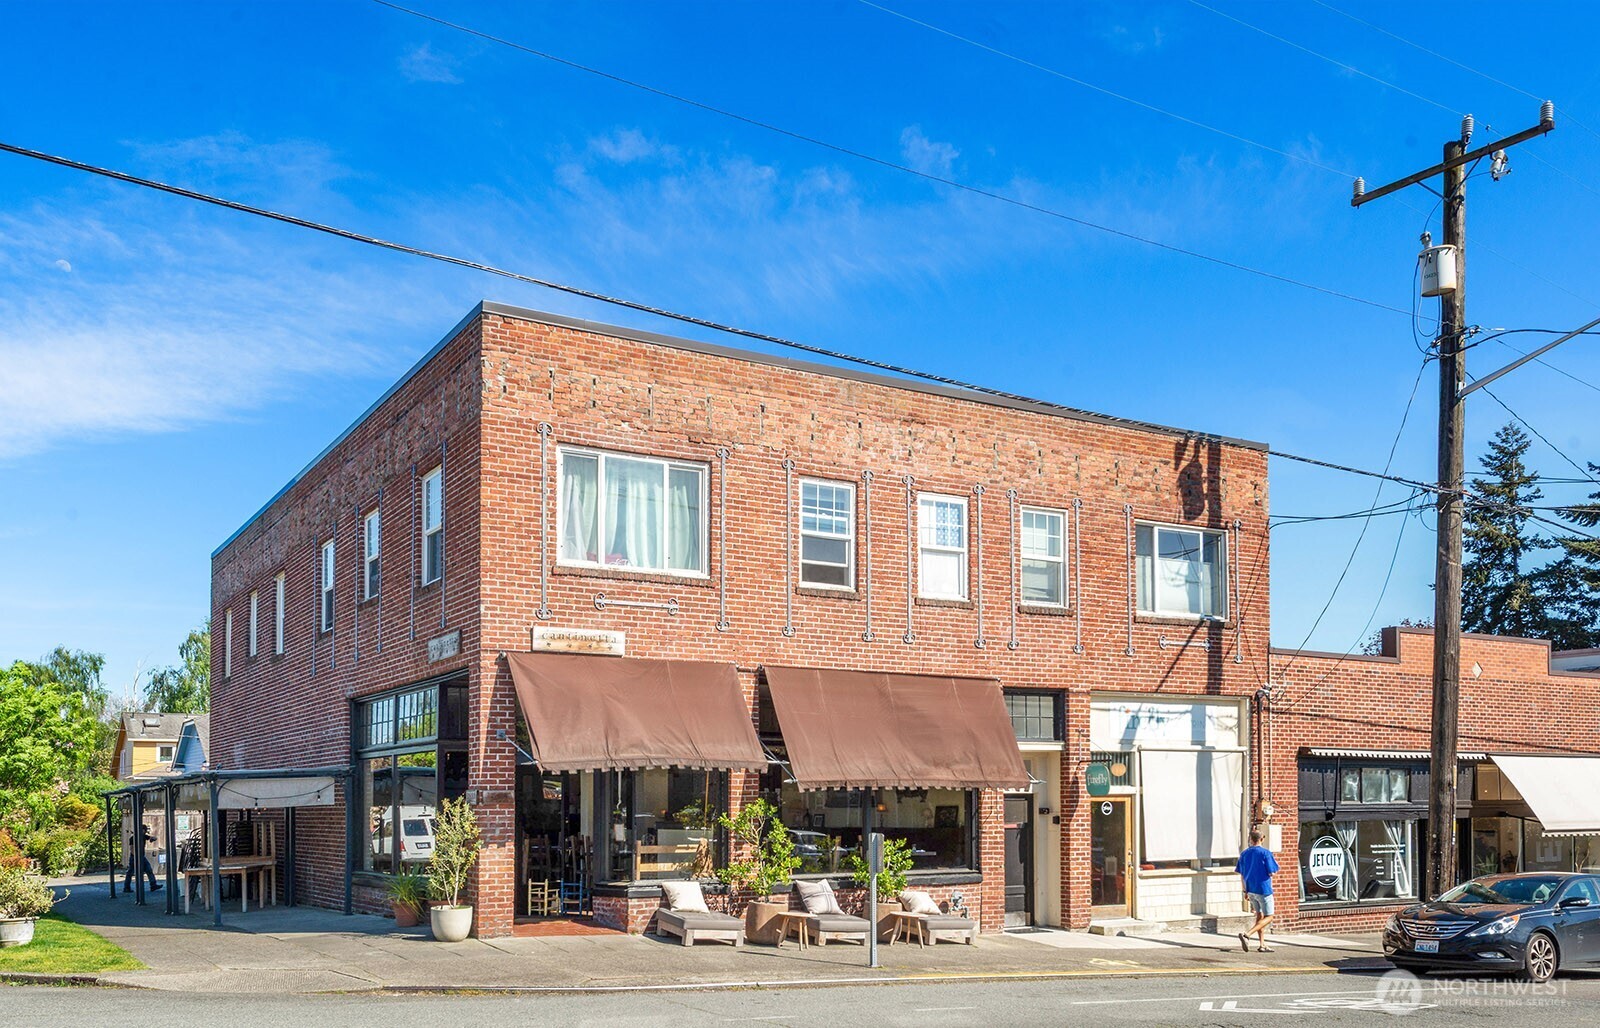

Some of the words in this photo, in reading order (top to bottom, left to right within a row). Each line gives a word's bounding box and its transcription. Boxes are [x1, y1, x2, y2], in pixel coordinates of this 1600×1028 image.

[1087, 773, 1108, 786] firefly
[1312, 853, 1325, 867] JET
[1326, 853, 1342, 866] CITY
